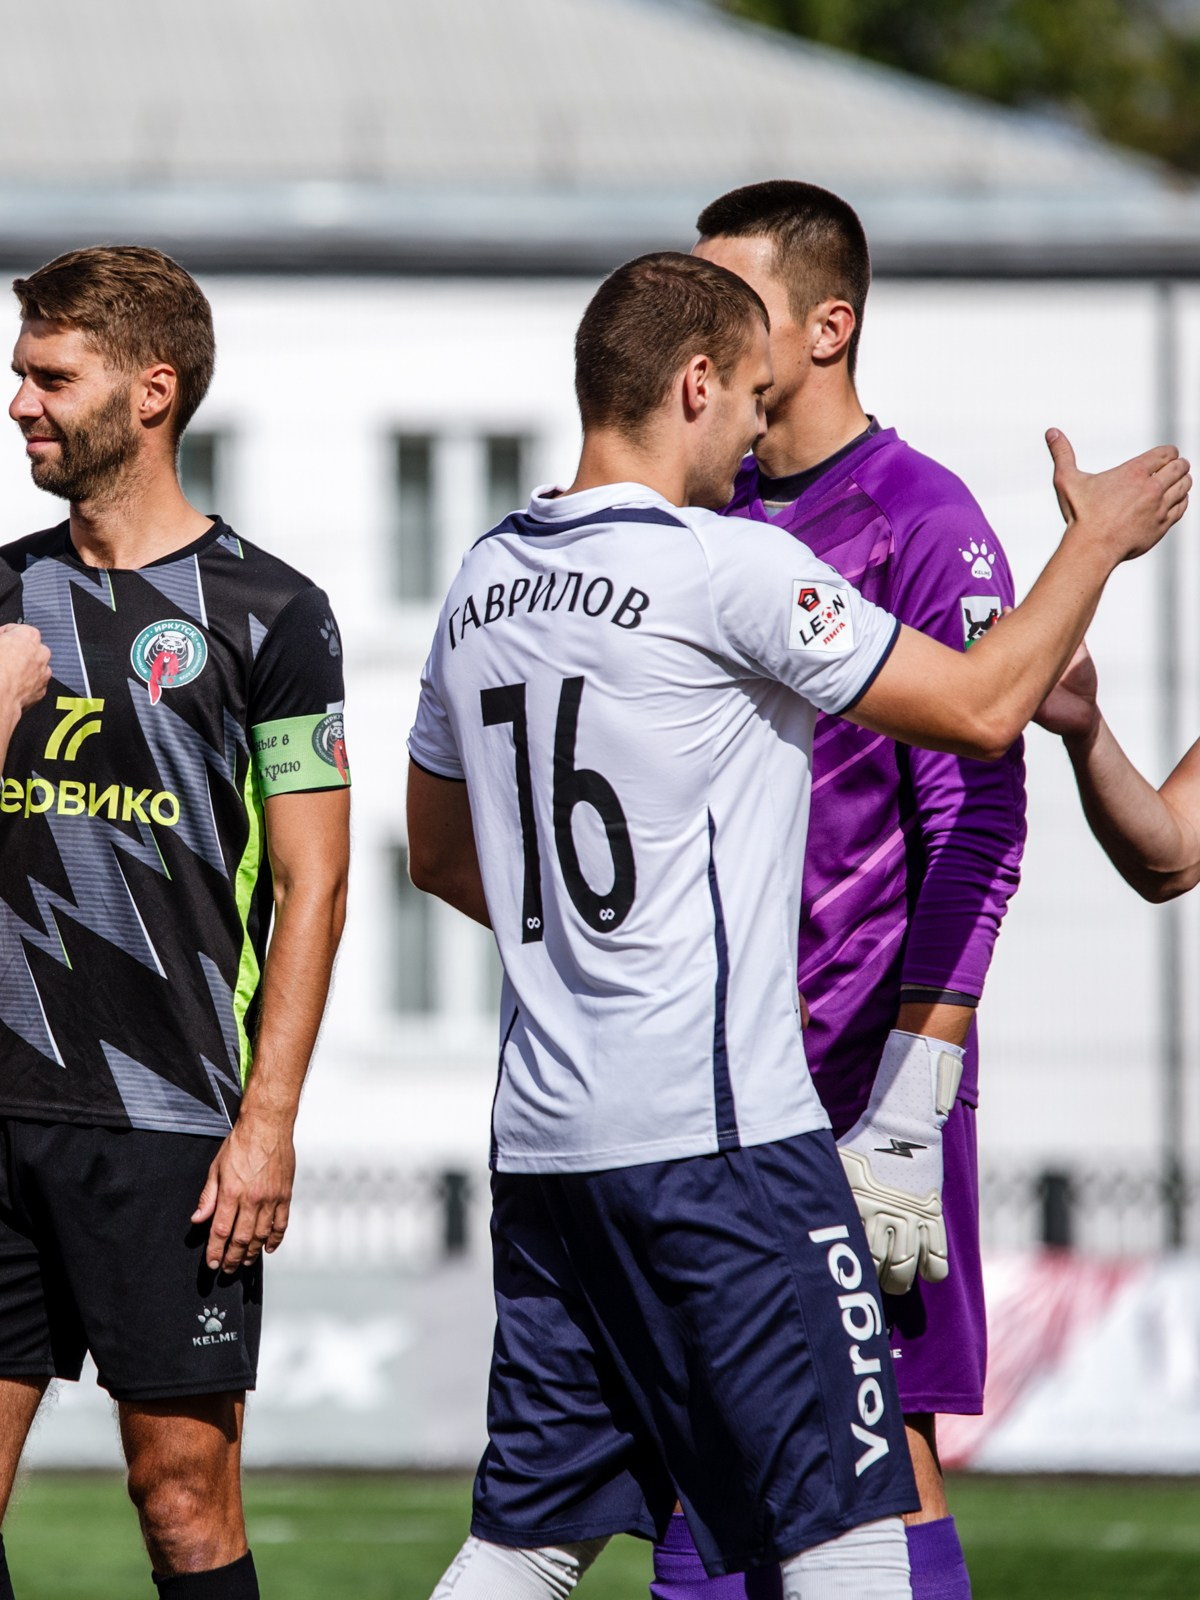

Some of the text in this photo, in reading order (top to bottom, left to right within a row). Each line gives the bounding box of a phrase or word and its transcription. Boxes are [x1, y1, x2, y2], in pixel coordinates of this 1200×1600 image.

[448, 571, 650, 650] ГАВРИЛОВ
[804, 594, 815, 606] 2
[153, 622, 197, 639] ИРКУТСК
[799, 593, 845, 646] LEON
[264, 760, 301, 782] краю
[479, 675, 637, 944] 16
[192, 1331, 239, 1347] KELME
[808, 1224, 890, 1477] Vorgol
